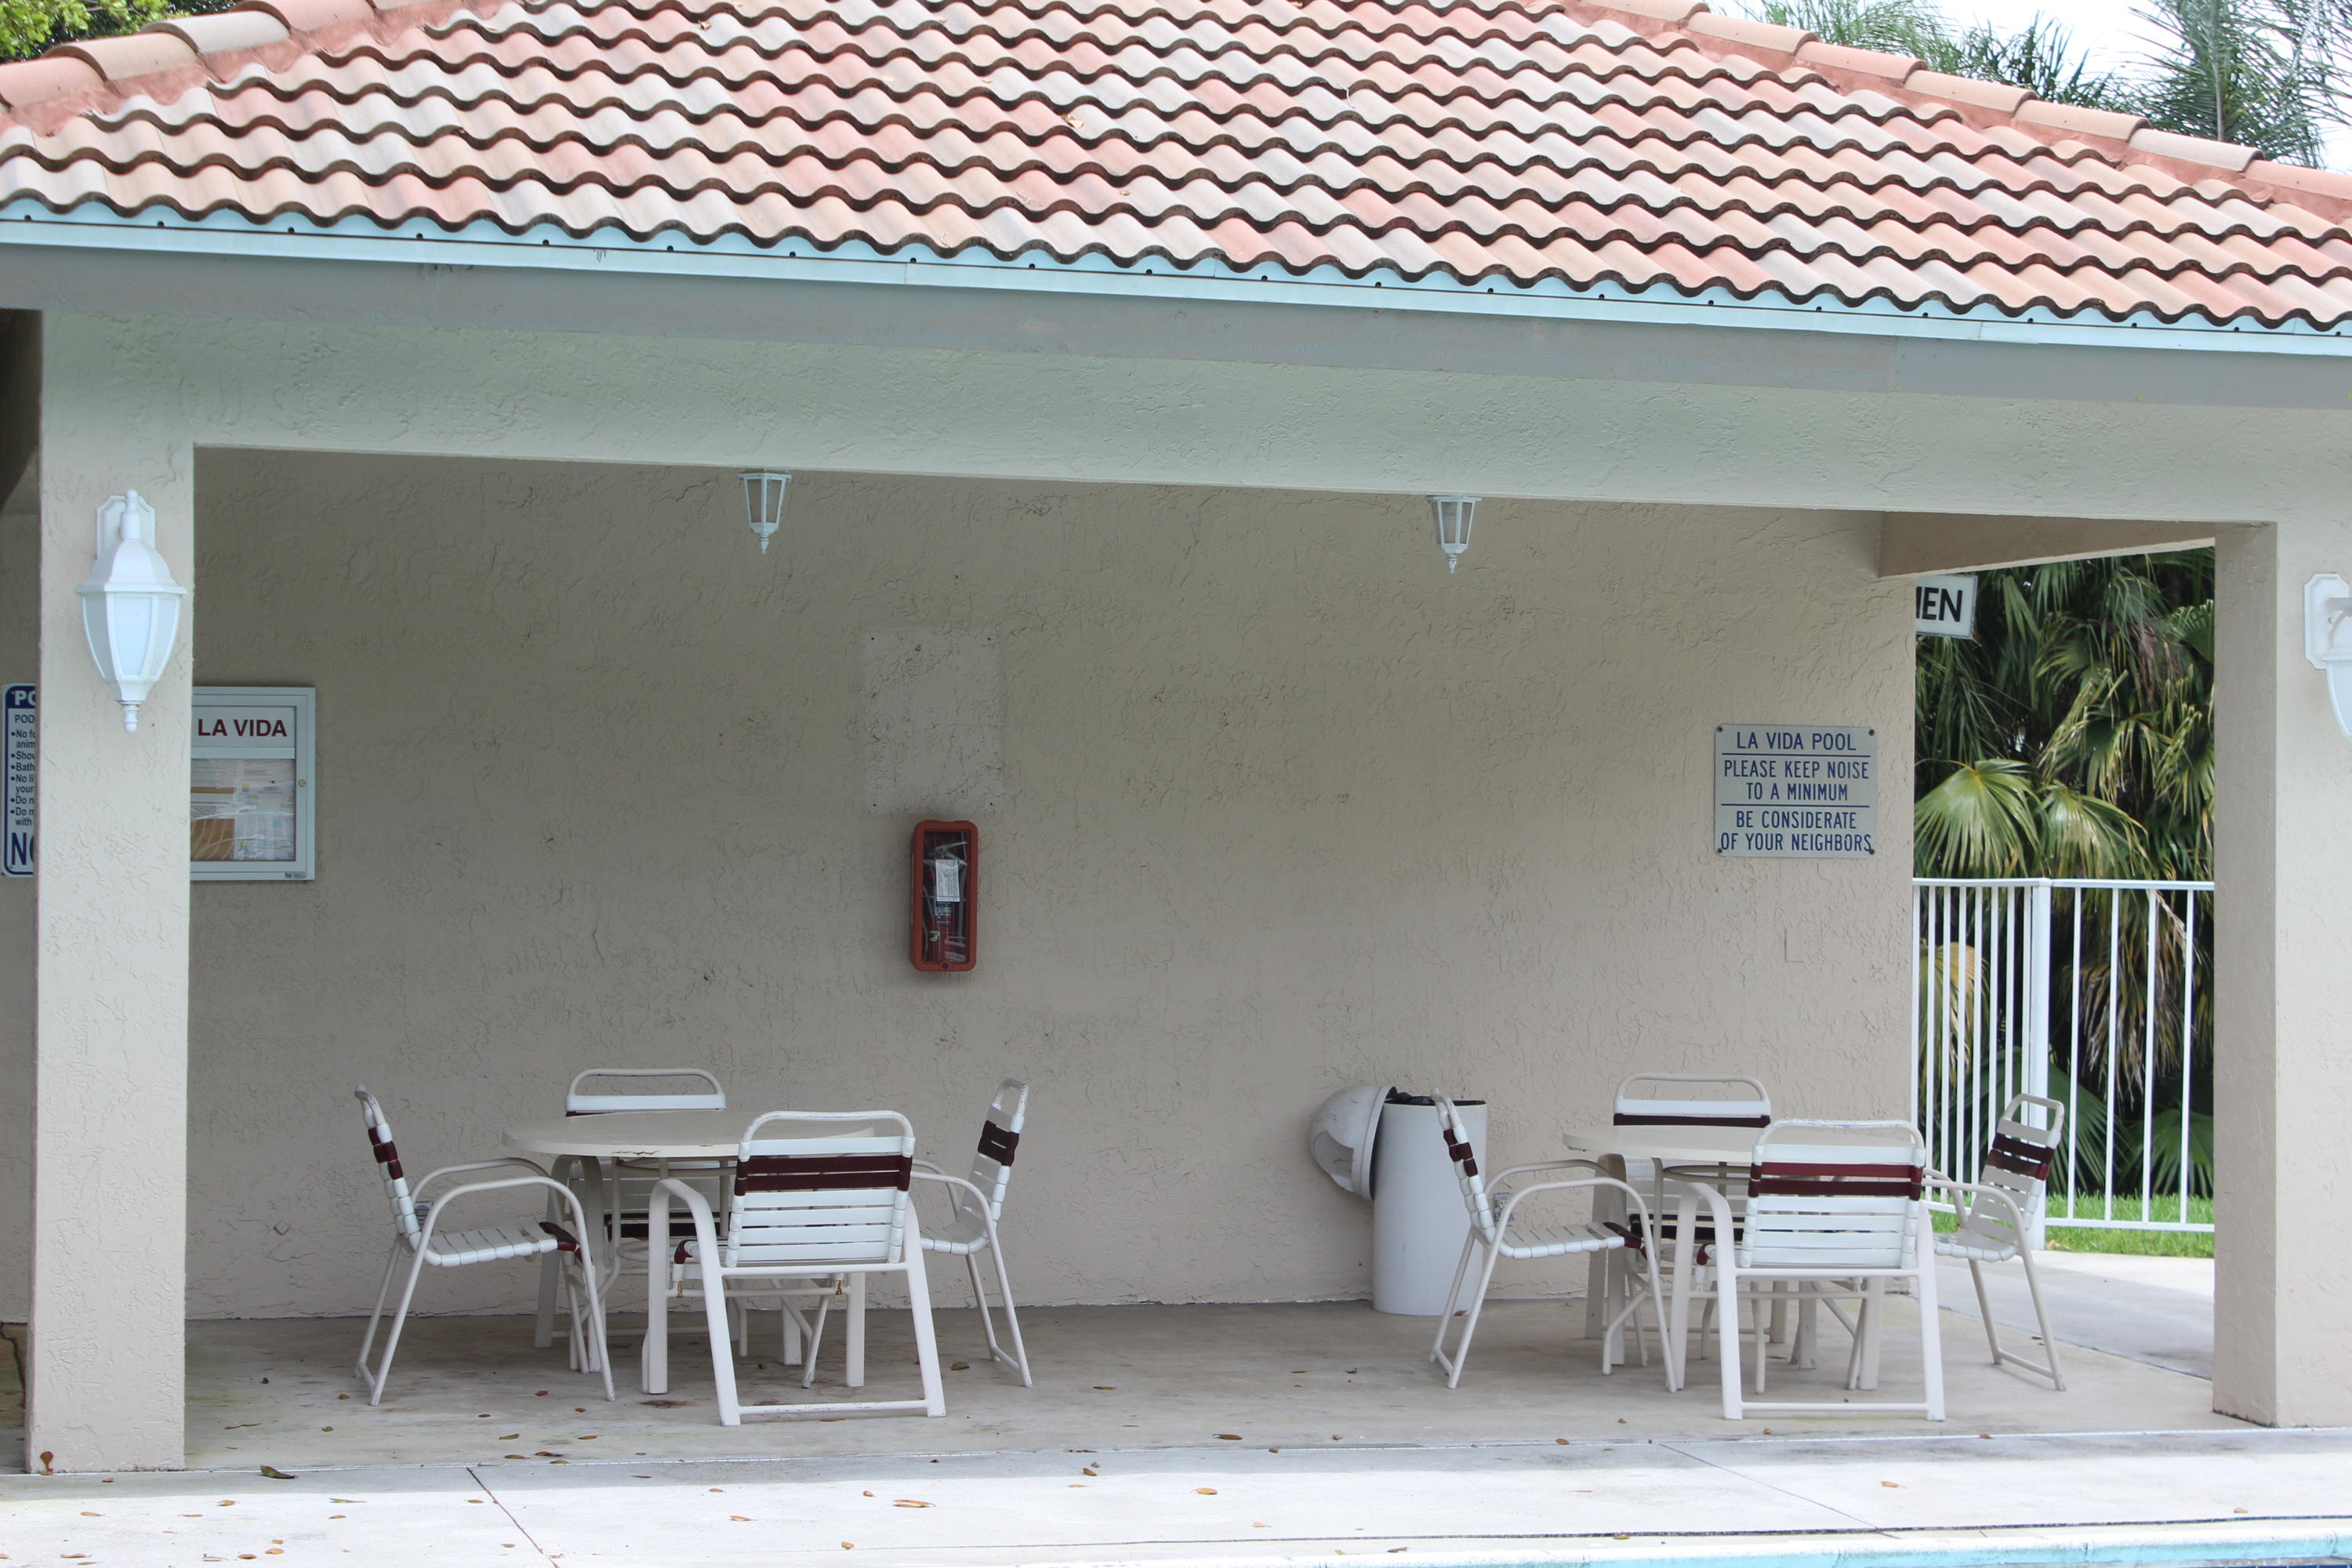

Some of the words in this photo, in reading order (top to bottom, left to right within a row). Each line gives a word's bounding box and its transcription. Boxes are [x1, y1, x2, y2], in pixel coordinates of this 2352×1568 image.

[1916, 586, 1963, 622] EN
[16, 729, 27, 738] No
[198, 718, 227, 736] LA
[233, 719, 288, 737] VIDA
[1737, 731, 1759, 749] LA
[1766, 731, 1804, 750] VIDA
[1812, 733, 1857, 751] POOL
[16, 774, 27, 782] No
[1724, 760, 1777, 778] PLEASE
[1784, 760, 1820, 779] KEEP
[1827, 761, 1869, 779] NOISE
[16, 796, 27, 804] Do
[1746, 782, 1762, 800] TO
[1770, 782, 1780, 800] A
[1787, 783, 1848, 801] MINIMUM
[16, 807, 27, 815] Do
[1736, 811, 1754, 828] BE
[1762, 811, 1857, 829] CONSIDERATE
[16, 818, 32, 826] with
[1721, 833, 1739, 851] OF
[1745, 833, 1783, 851] YOUR
[1791, 833, 1872, 852] NEIGHBORS
